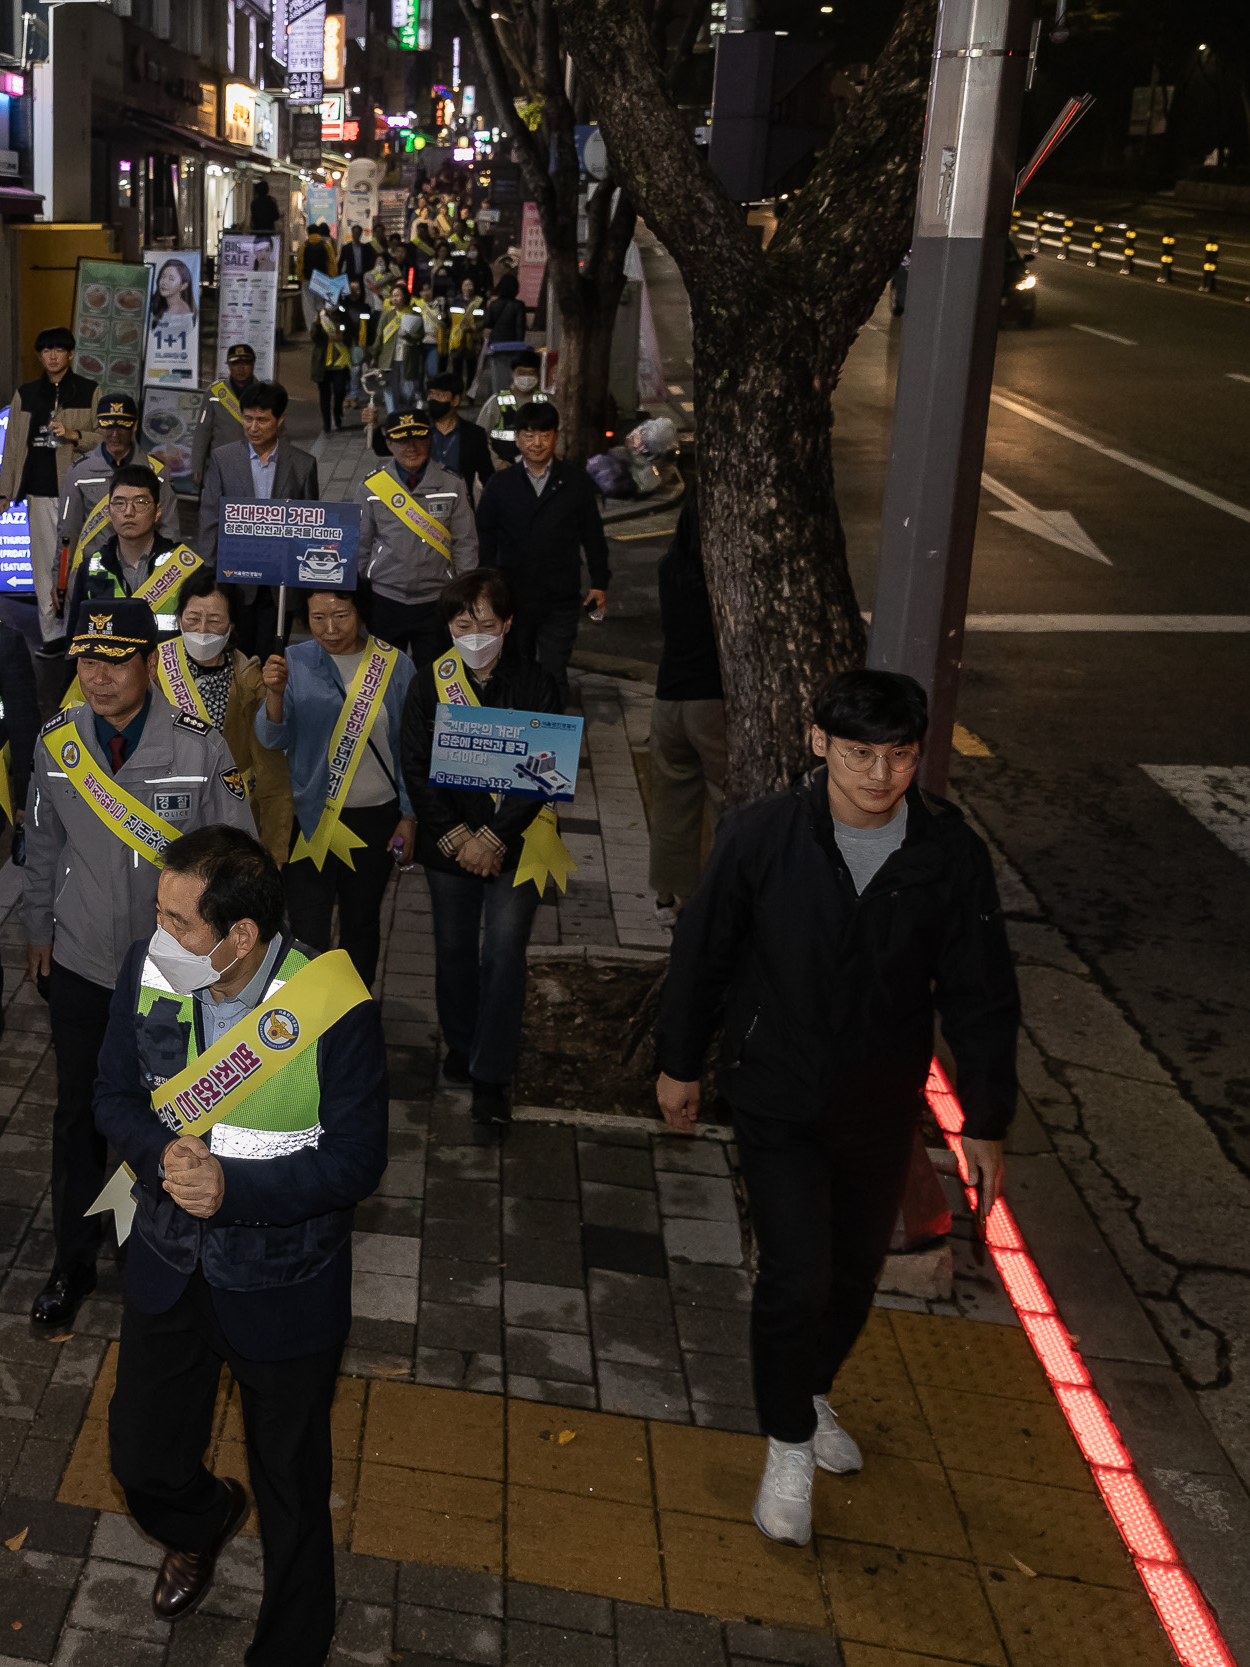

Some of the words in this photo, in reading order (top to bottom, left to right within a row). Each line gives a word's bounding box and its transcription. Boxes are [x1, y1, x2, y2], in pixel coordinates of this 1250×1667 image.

[224, 254, 250, 267] SALE
[154, 331, 187, 350] 1+1
[0, 512, 27, 525] JAZZ
[225, 504, 285, 524] 건대맛의
[288, 508, 325, 525] 거리!
[225, 523, 254, 535] 청춘에
[255, 524, 283, 537] 안전과
[284, 527, 312, 538] 품격을
[313, 528, 342, 540] 더하다
[357, 653, 387, 698] 안전하고
[345, 694, 371, 737] 건전한
[440, 734, 470, 748] 청춘에
[472, 737, 503, 752] 안전과
[330, 734, 357, 774] 청년의
[445, 775, 489, 788] 긴급신고는
[489, 778, 512, 789] 112
[83, 772, 127, 822] 범죄없는
[158, 810, 189, 819] POLICE
[175, 1042, 263, 1124] 범죄없는
